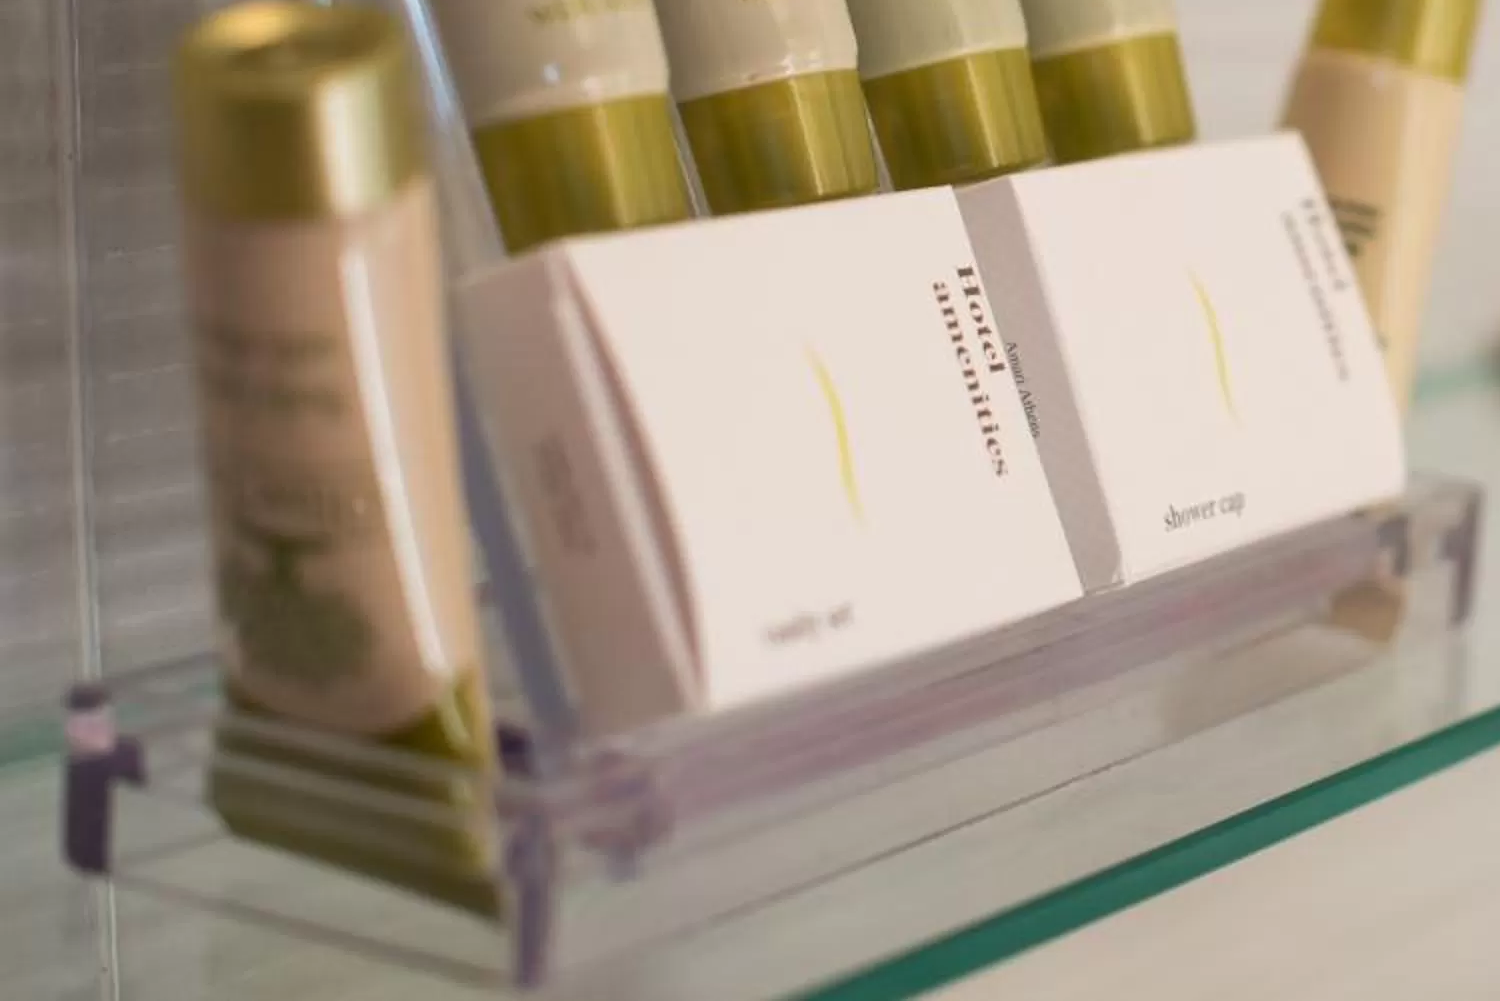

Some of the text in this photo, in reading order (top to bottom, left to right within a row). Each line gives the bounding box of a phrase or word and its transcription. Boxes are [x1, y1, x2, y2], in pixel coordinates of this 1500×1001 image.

[956, 265, 1006, 373] Hotel
[932, 280, 1008, 477] amenities
[1162, 502, 1217, 533] shower
